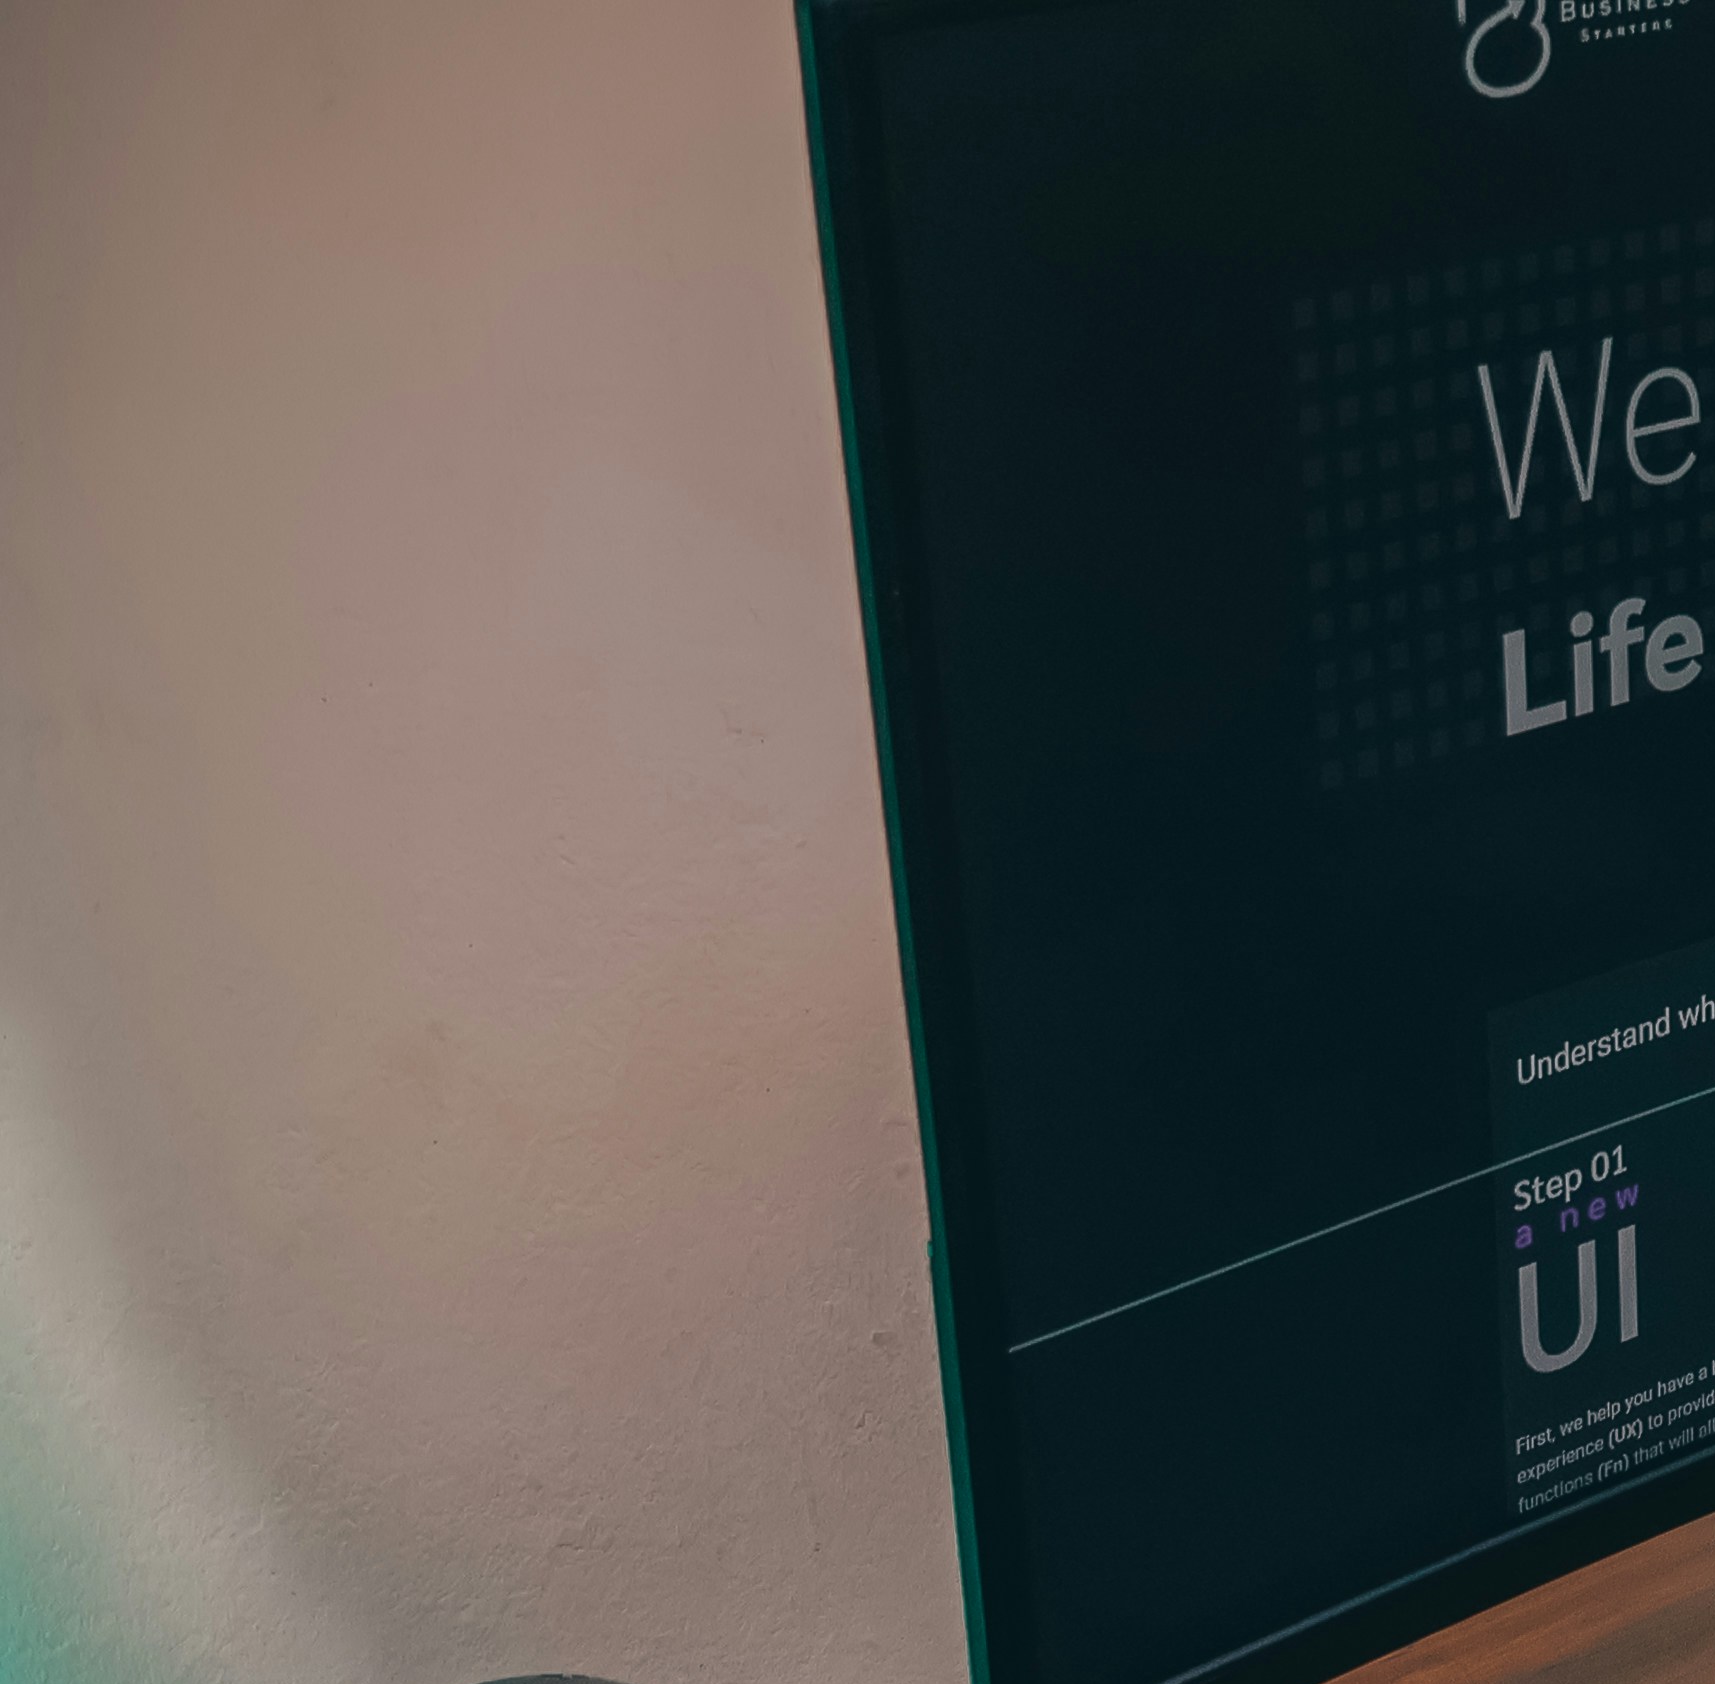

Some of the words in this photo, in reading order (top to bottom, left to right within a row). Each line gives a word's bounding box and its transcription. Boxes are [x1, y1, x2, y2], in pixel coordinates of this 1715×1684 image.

[1560, 0, 1689, 22] BUSINE
[1477, 336, 1703, 519] We
[1502, 597, 1704, 736] Life
[1516, 1006, 1671, 1085] Understand
[1513, 1167, 1583, 1213] Step
[1590, 1144, 1628, 1182] 01
[1514, 1223, 1533, 1249] a
[1559, 1184, 1640, 1233] new
[1518, 1223, 1639, 1374] UI
[1515, 1427, 1556, 1455] First,
[1559, 1417, 1583, 1437] we
[1586, 1401, 1621, 1427] help
[1624, 1388, 1653, 1415] you
[1657, 1372, 1695, 1398] have
[1698, 1366, 1708, 1381] a
